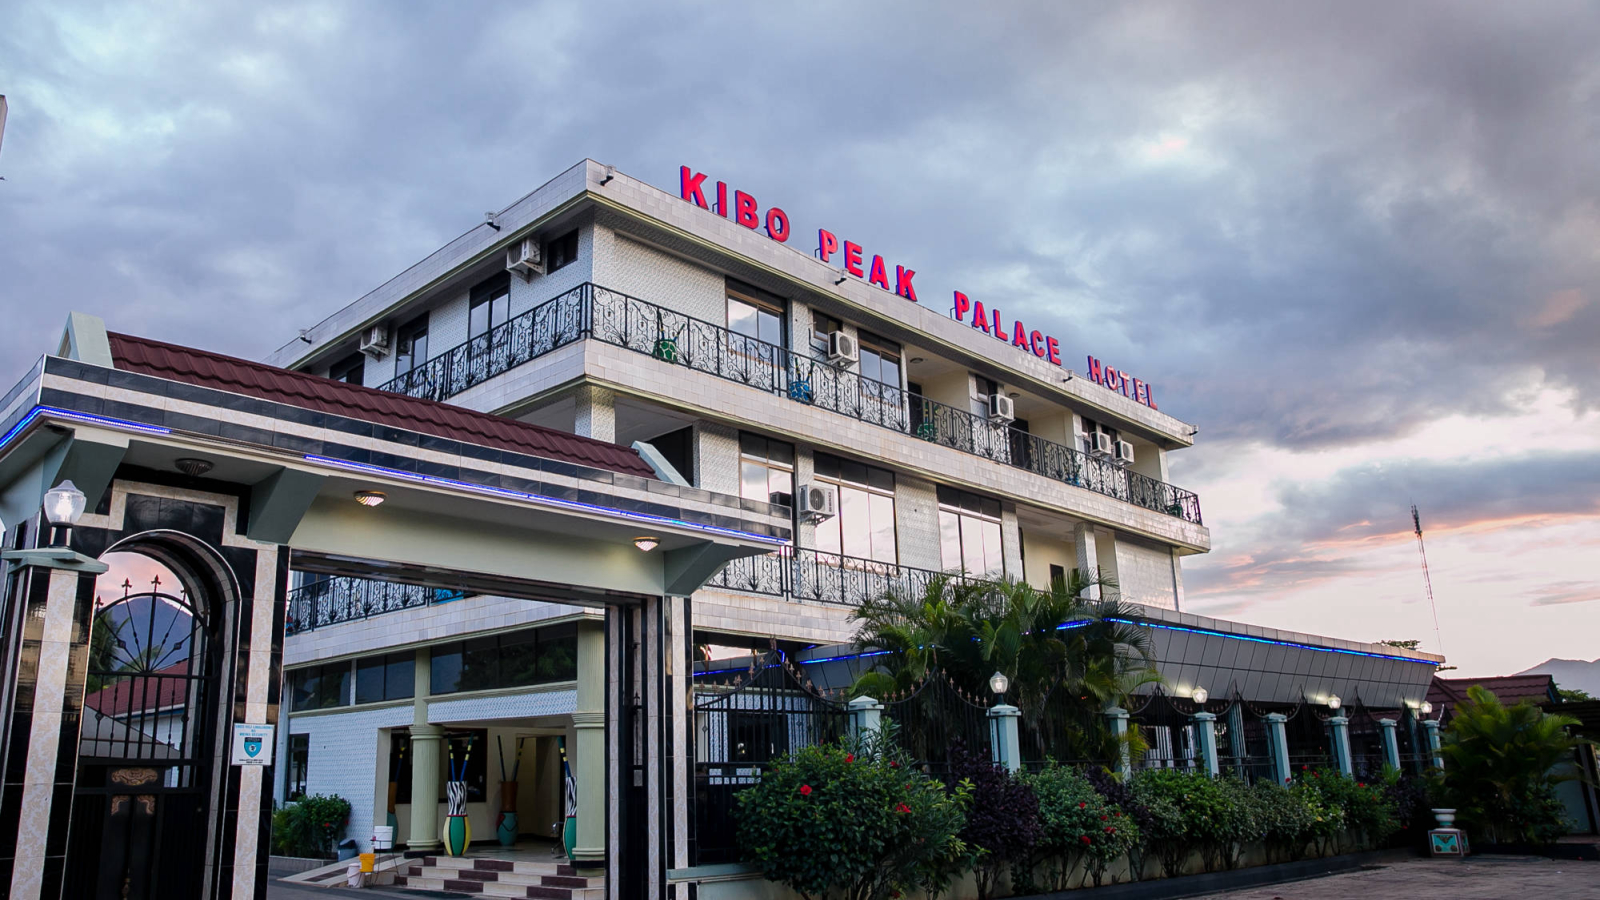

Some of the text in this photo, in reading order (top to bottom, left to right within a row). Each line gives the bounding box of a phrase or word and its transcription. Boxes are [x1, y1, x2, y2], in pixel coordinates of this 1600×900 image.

[680, 165, 1158, 410] KIBO PEAK PALACE HOTEL
